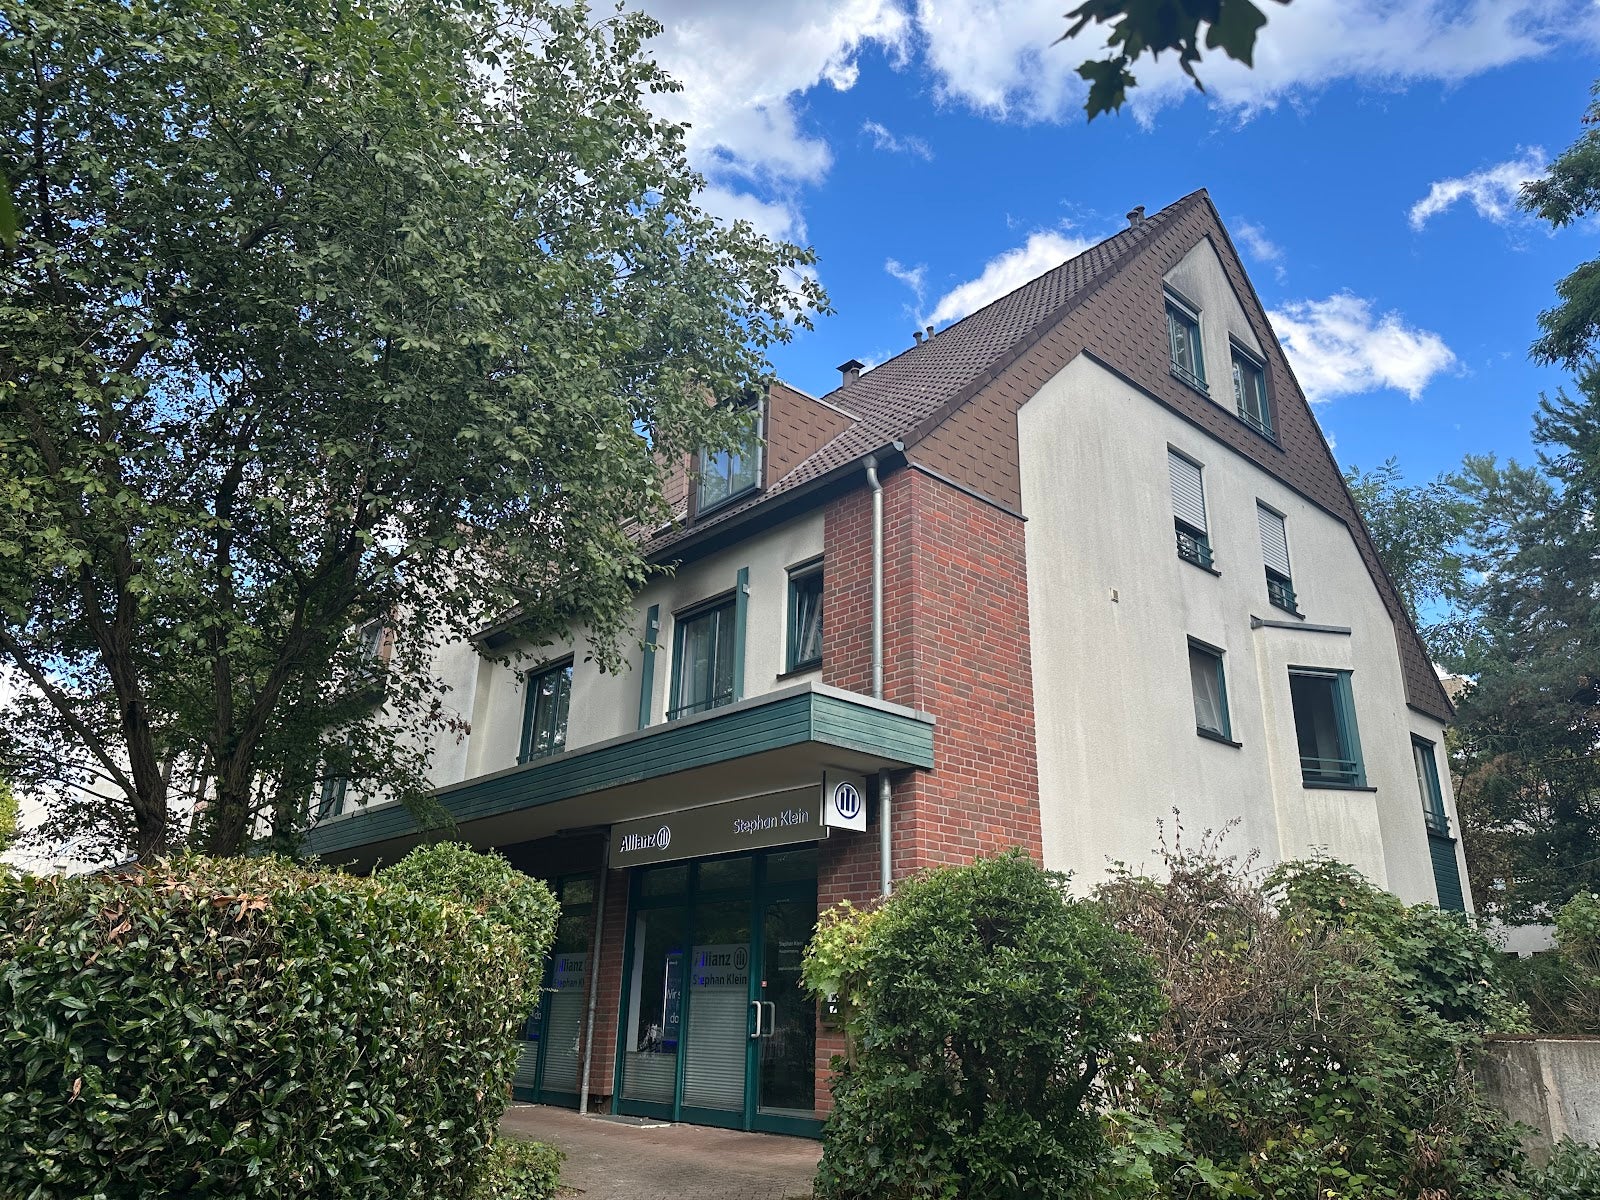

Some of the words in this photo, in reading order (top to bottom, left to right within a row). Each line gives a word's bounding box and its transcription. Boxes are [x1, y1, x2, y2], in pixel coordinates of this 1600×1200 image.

[733, 815, 778, 834] Stephan
[780, 808, 809, 826] Klein
[620, 834, 656, 852] Allianz
[694, 951, 731, 967] Allianz
[693, 973, 725, 988] Stephan
[726, 973, 747, 985] Klein
